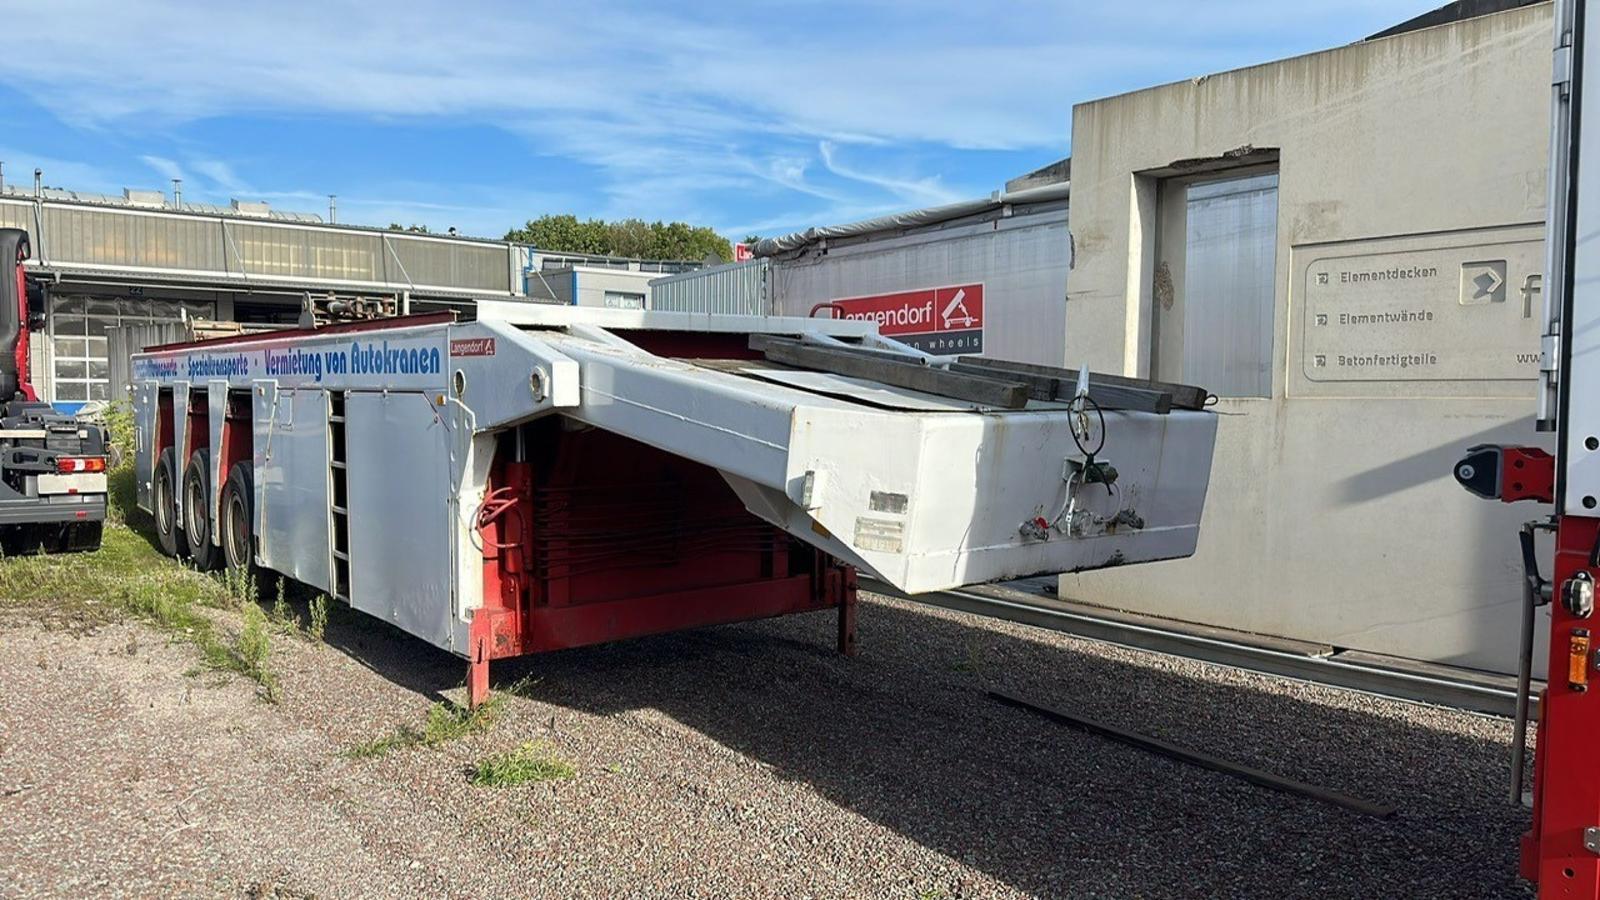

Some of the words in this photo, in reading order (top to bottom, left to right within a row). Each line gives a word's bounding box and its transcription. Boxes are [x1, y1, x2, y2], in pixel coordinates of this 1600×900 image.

[1340, 266, 1437, 283] Elementdecken
[1339, 309, 1433, 325] Elementwände
[450, 340, 484, 356] Langendorf
[928, 336, 979, 349] wheels
[187, 353, 249, 382] Spezialtransporte
[264, 348, 322, 381] Vermietung
[325, 351, 347, 374] von
[351, 341, 440, 375] Autokranen
[1338, 353, 1437, 368] Betonfertigteile
